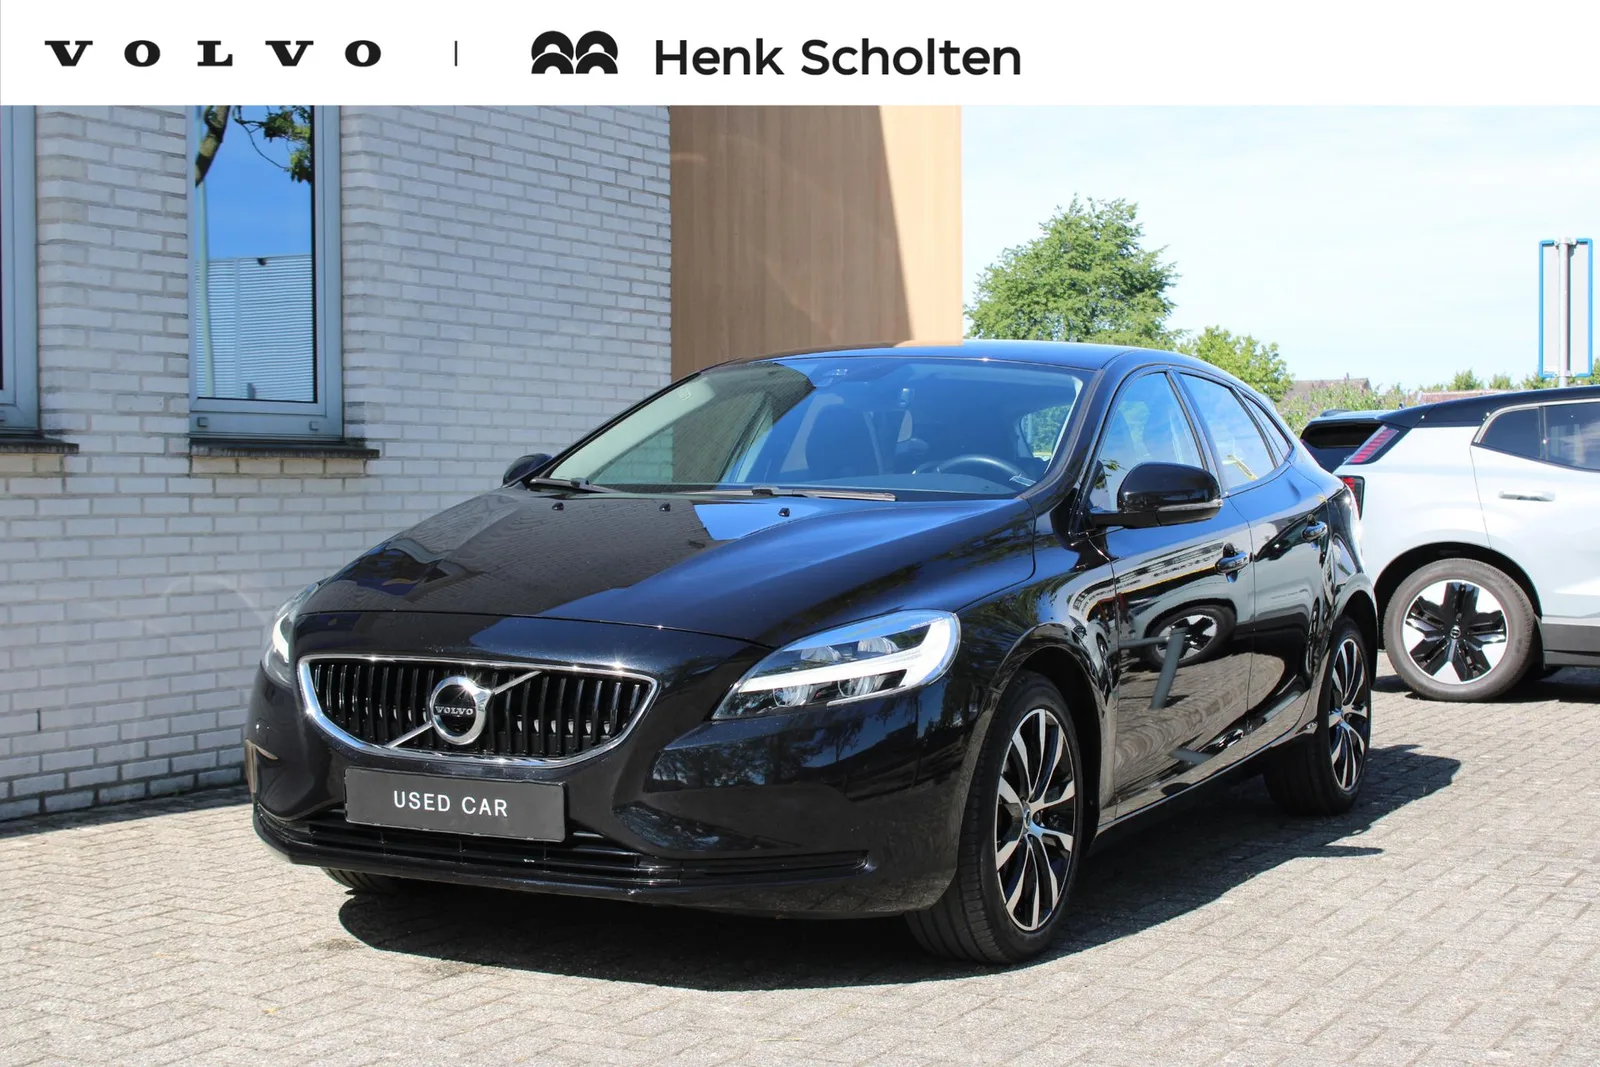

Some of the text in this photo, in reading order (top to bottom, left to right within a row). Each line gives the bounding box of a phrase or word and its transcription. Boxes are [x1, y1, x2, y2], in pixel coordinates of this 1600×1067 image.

[435, 706, 474, 715] VOLVO
[393, 790, 508, 817] USED CAR
